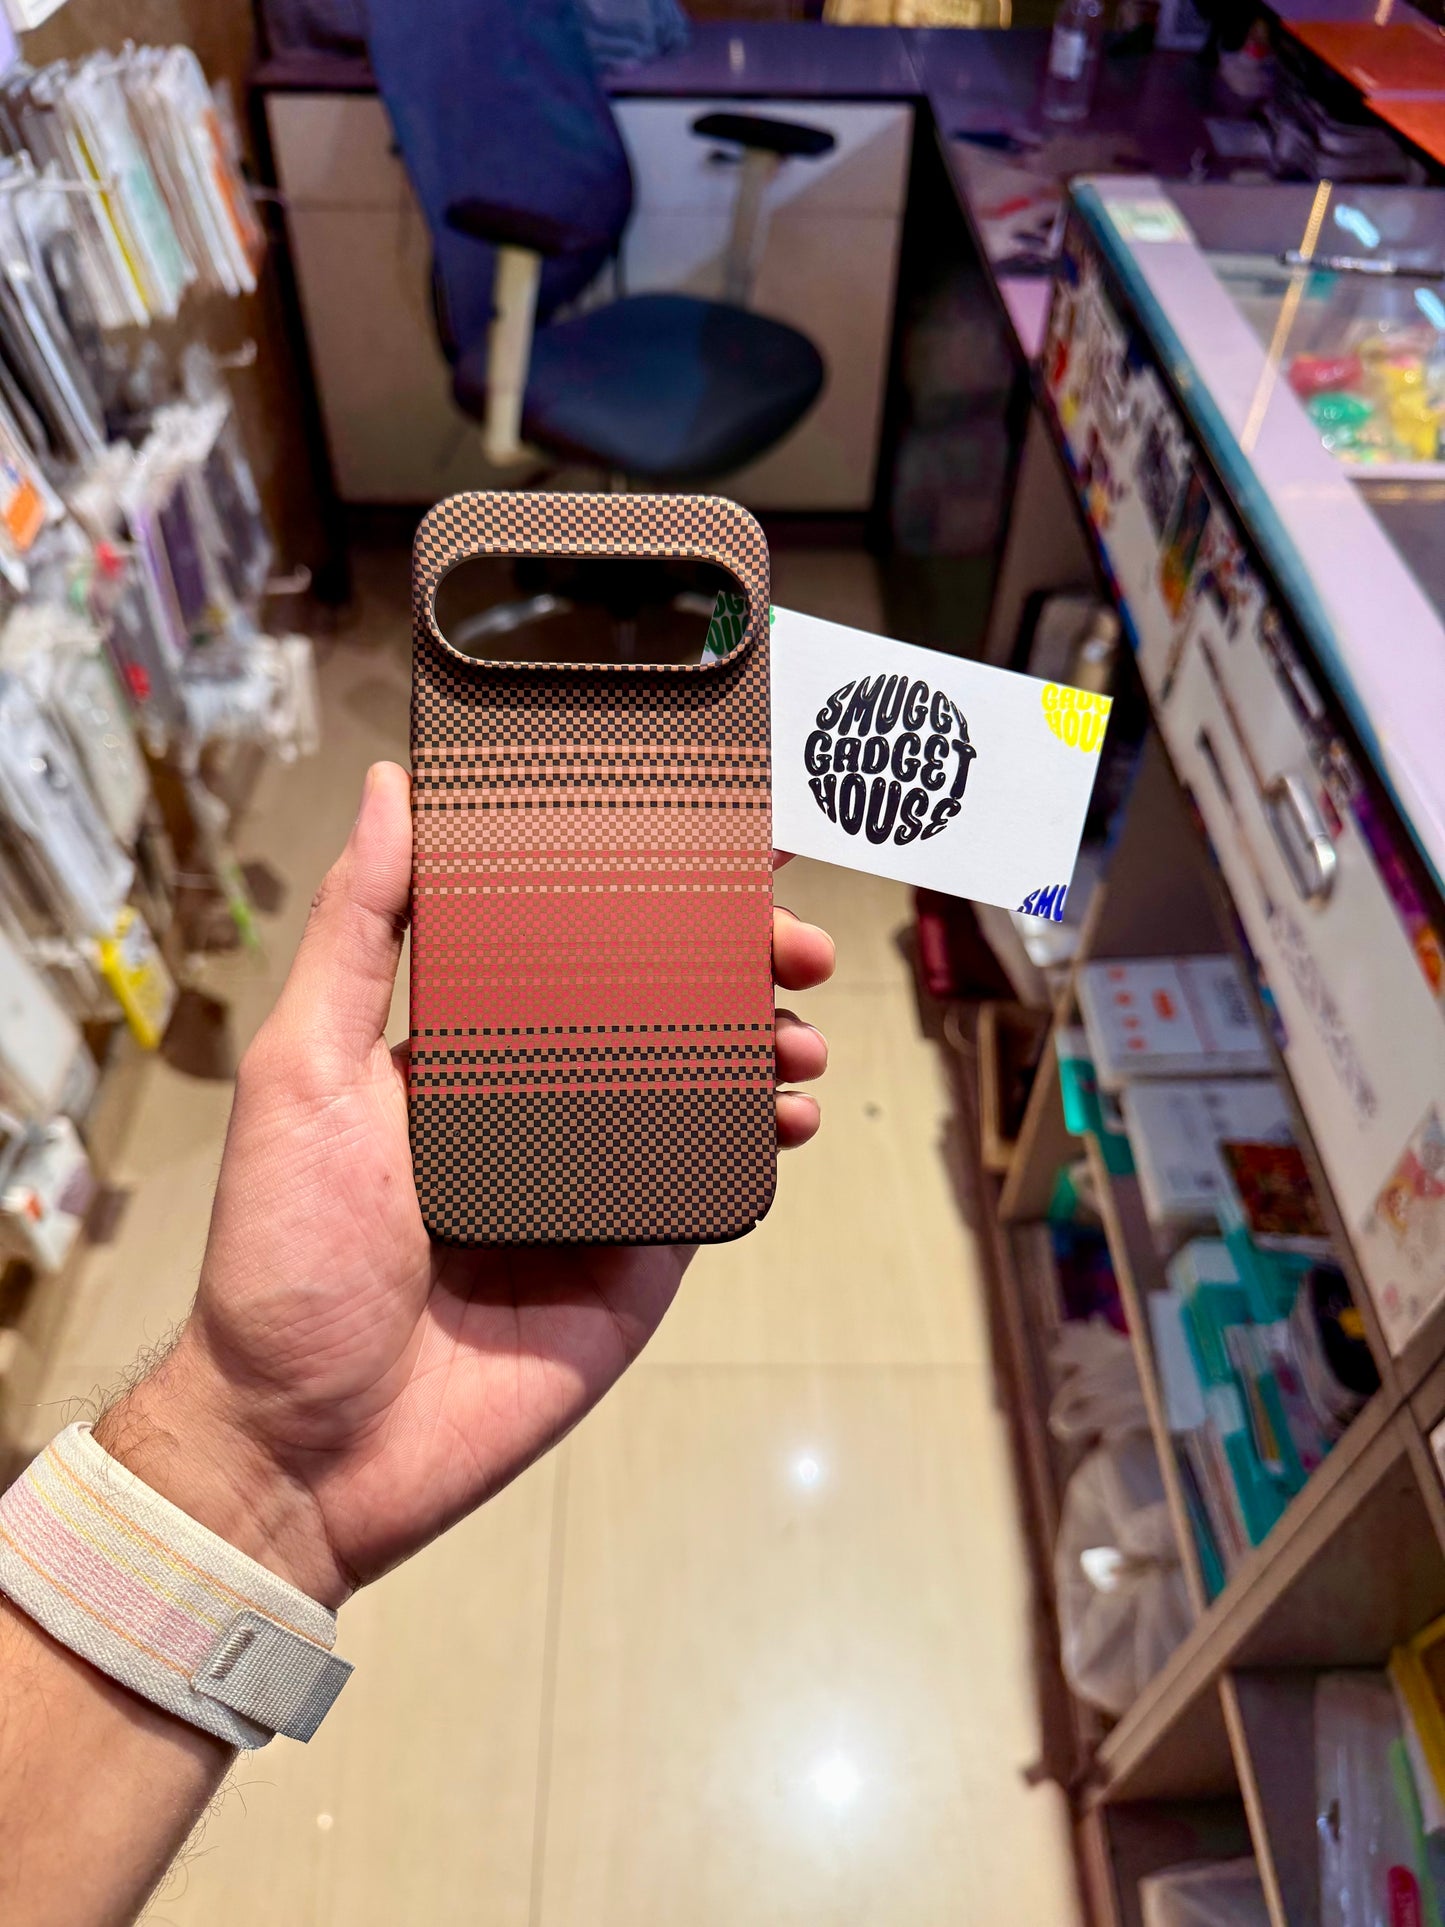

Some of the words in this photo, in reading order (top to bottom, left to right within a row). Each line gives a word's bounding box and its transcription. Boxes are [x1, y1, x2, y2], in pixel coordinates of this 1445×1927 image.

[816, 674, 970, 742] SMUGGY
[804, 730, 977, 800] GADGET
[808, 774, 962, 846] HOUSE
